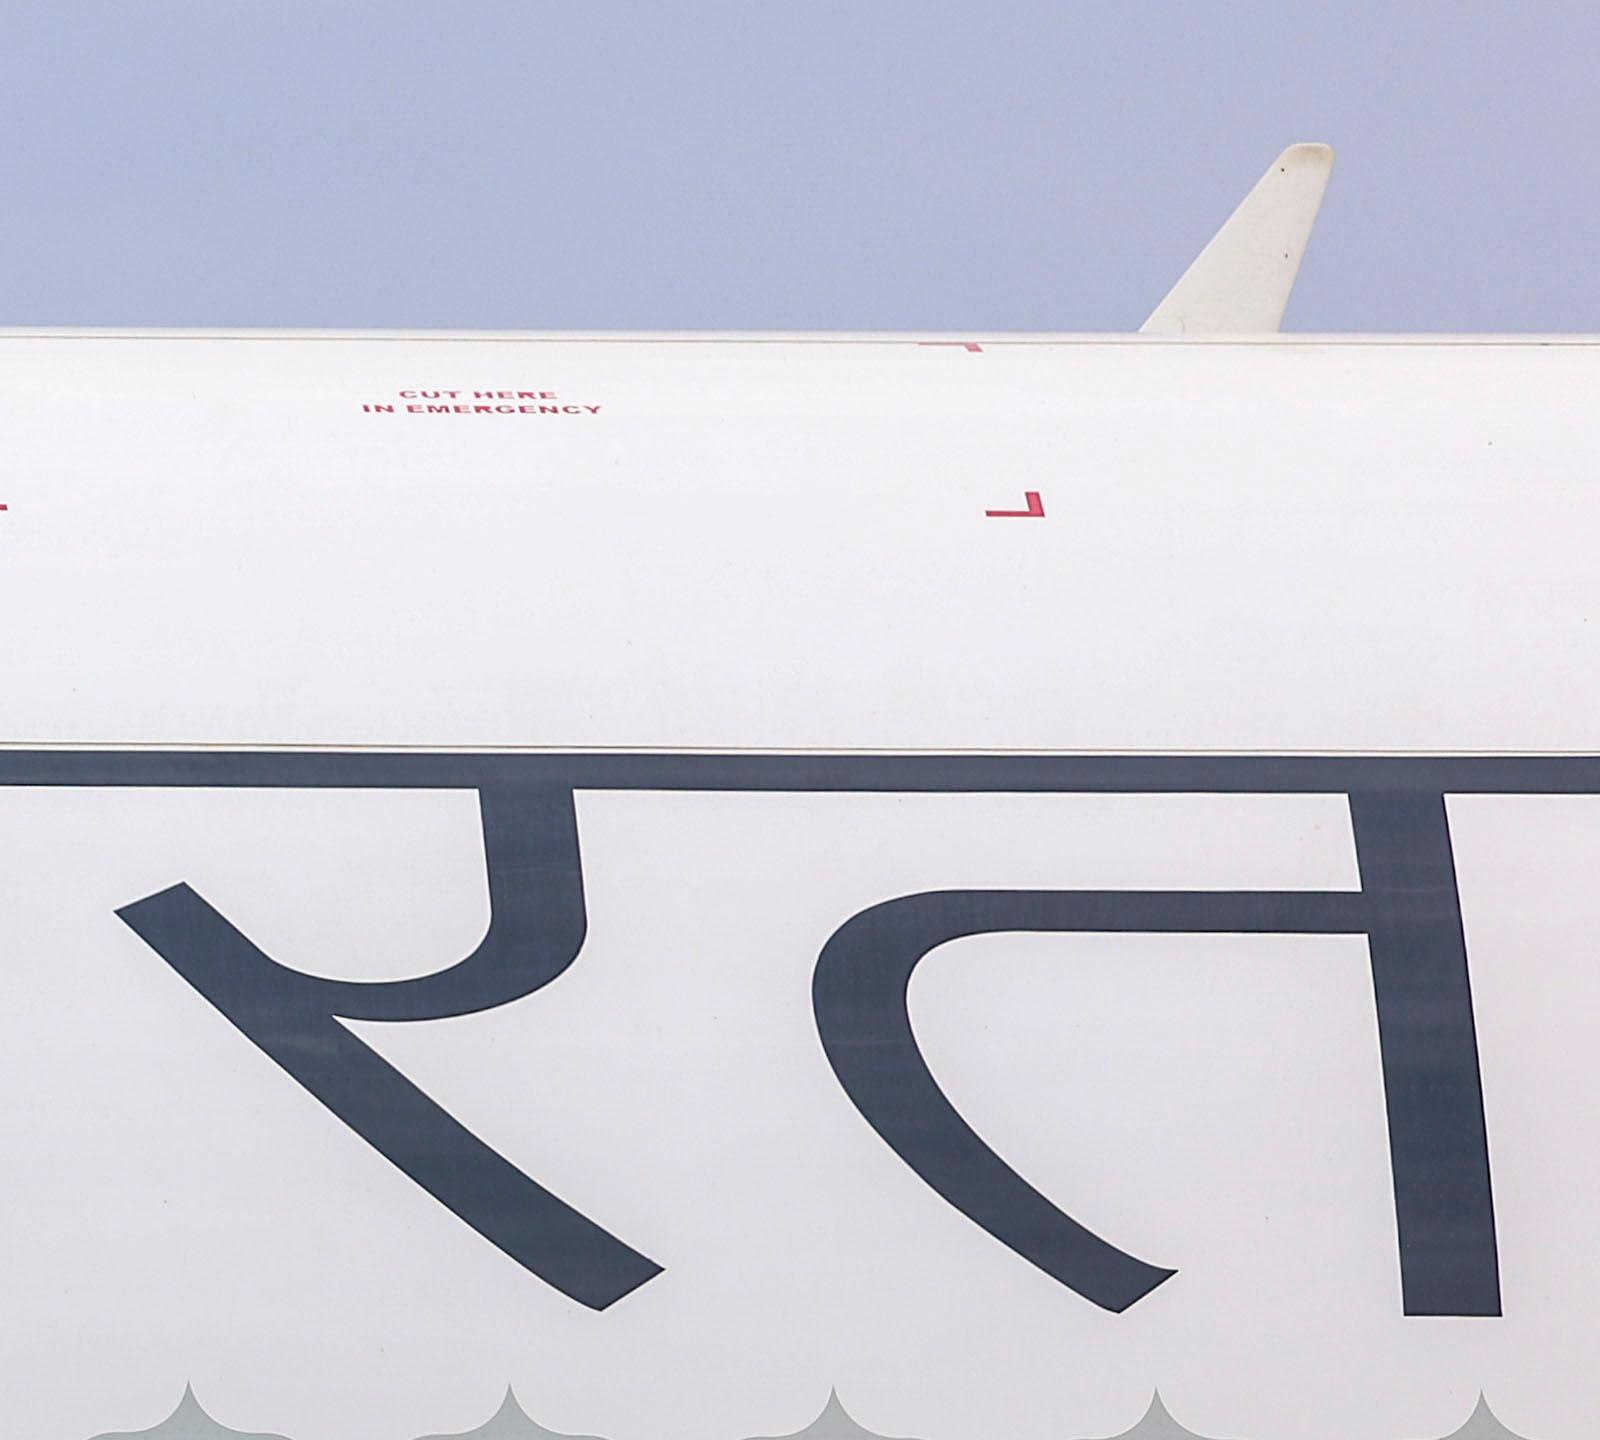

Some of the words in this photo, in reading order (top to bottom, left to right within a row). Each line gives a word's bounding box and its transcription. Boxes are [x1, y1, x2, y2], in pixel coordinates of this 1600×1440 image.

[398, 390, 461, 399] CUT
[473, 390, 559, 400] HERE
[362, 404, 395, 413] IN
[406, 404, 602, 414] EMERGENCY
